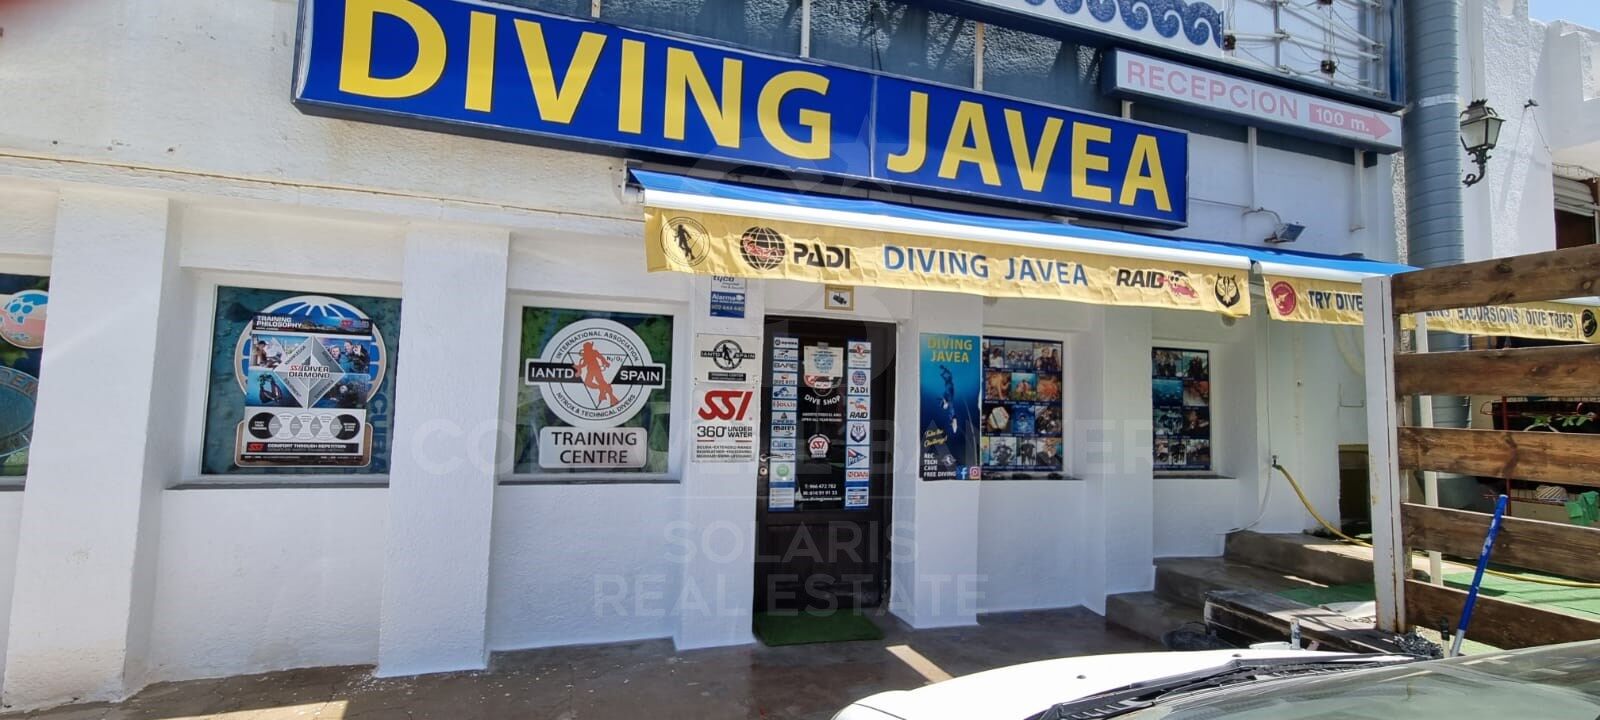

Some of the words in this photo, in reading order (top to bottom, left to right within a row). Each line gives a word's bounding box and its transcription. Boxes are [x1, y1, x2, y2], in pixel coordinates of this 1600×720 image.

[338, 0, 831, 160] DIVING
[887, 91, 1172, 212] JAVEA
[1126, 60, 1298, 119] RECEPCION
[1315, 107, 1345, 130] 100
[1349, 117, 1371, 134] m.
[793, 242, 850, 269] PADI
[883, 245, 989, 278] DIVING
[1004, 257, 1089, 286] JAVEA
[1116, 269, 1165, 289] RAID
[1308, 290, 1331, 310] TRY
[257, 315, 292, 323] TRAINING
[1457, 306, 1519, 324] EXCURSIONS
[1525, 310, 1547, 326] DIVE
[1549, 312, 1574, 329] TRIPS
[556, 331, 601, 359] INTERNATIONAL
[604, 332, 639, 362] ASSOCIATION
[928, 337, 973, 350] DIVING
[931, 351, 969, 363] JAVEA
[288, 371, 330, 379] DIAMOND
[531, 367, 574, 379] IANTD
[620, 370, 660, 381] SPAIN
[581, 407, 617, 417] TECHNICAL
[617, 394, 636, 412] DIVERS
[697, 390, 753, 421] SSI
[804, 394, 821, 405] DIVE
[823, 394, 841, 406] SHOP
[849, 411, 868, 419] RAID
[551, 431, 637, 446] TRAINING
[559, 449, 628, 464] CENTRE
